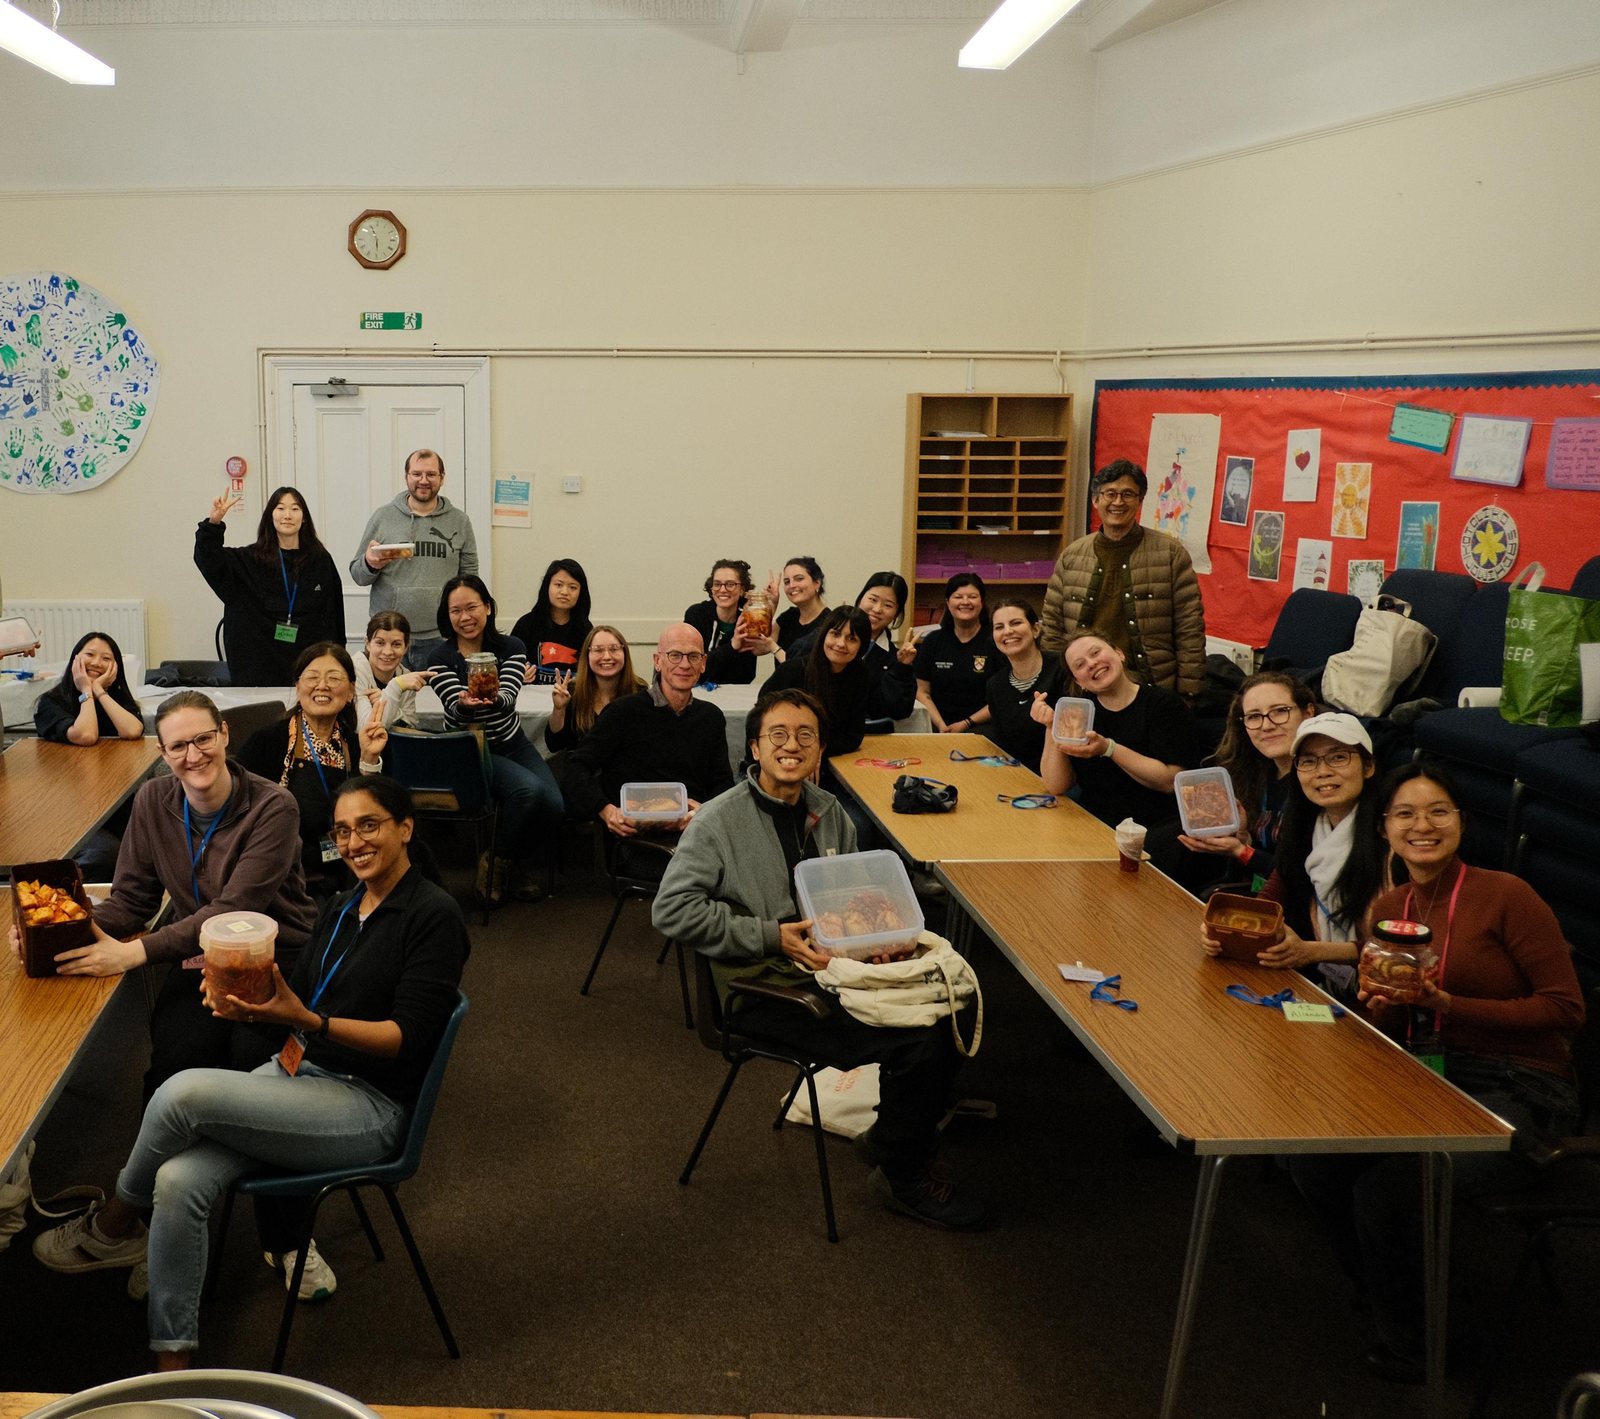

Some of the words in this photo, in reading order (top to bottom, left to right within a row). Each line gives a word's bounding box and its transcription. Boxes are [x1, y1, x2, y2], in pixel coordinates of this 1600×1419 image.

[365, 312, 384, 320] FIRE
[365, 321, 384, 329] EXIT
[399, 541, 447, 559] UMA
[1504, 646, 1535, 664] EEP.
